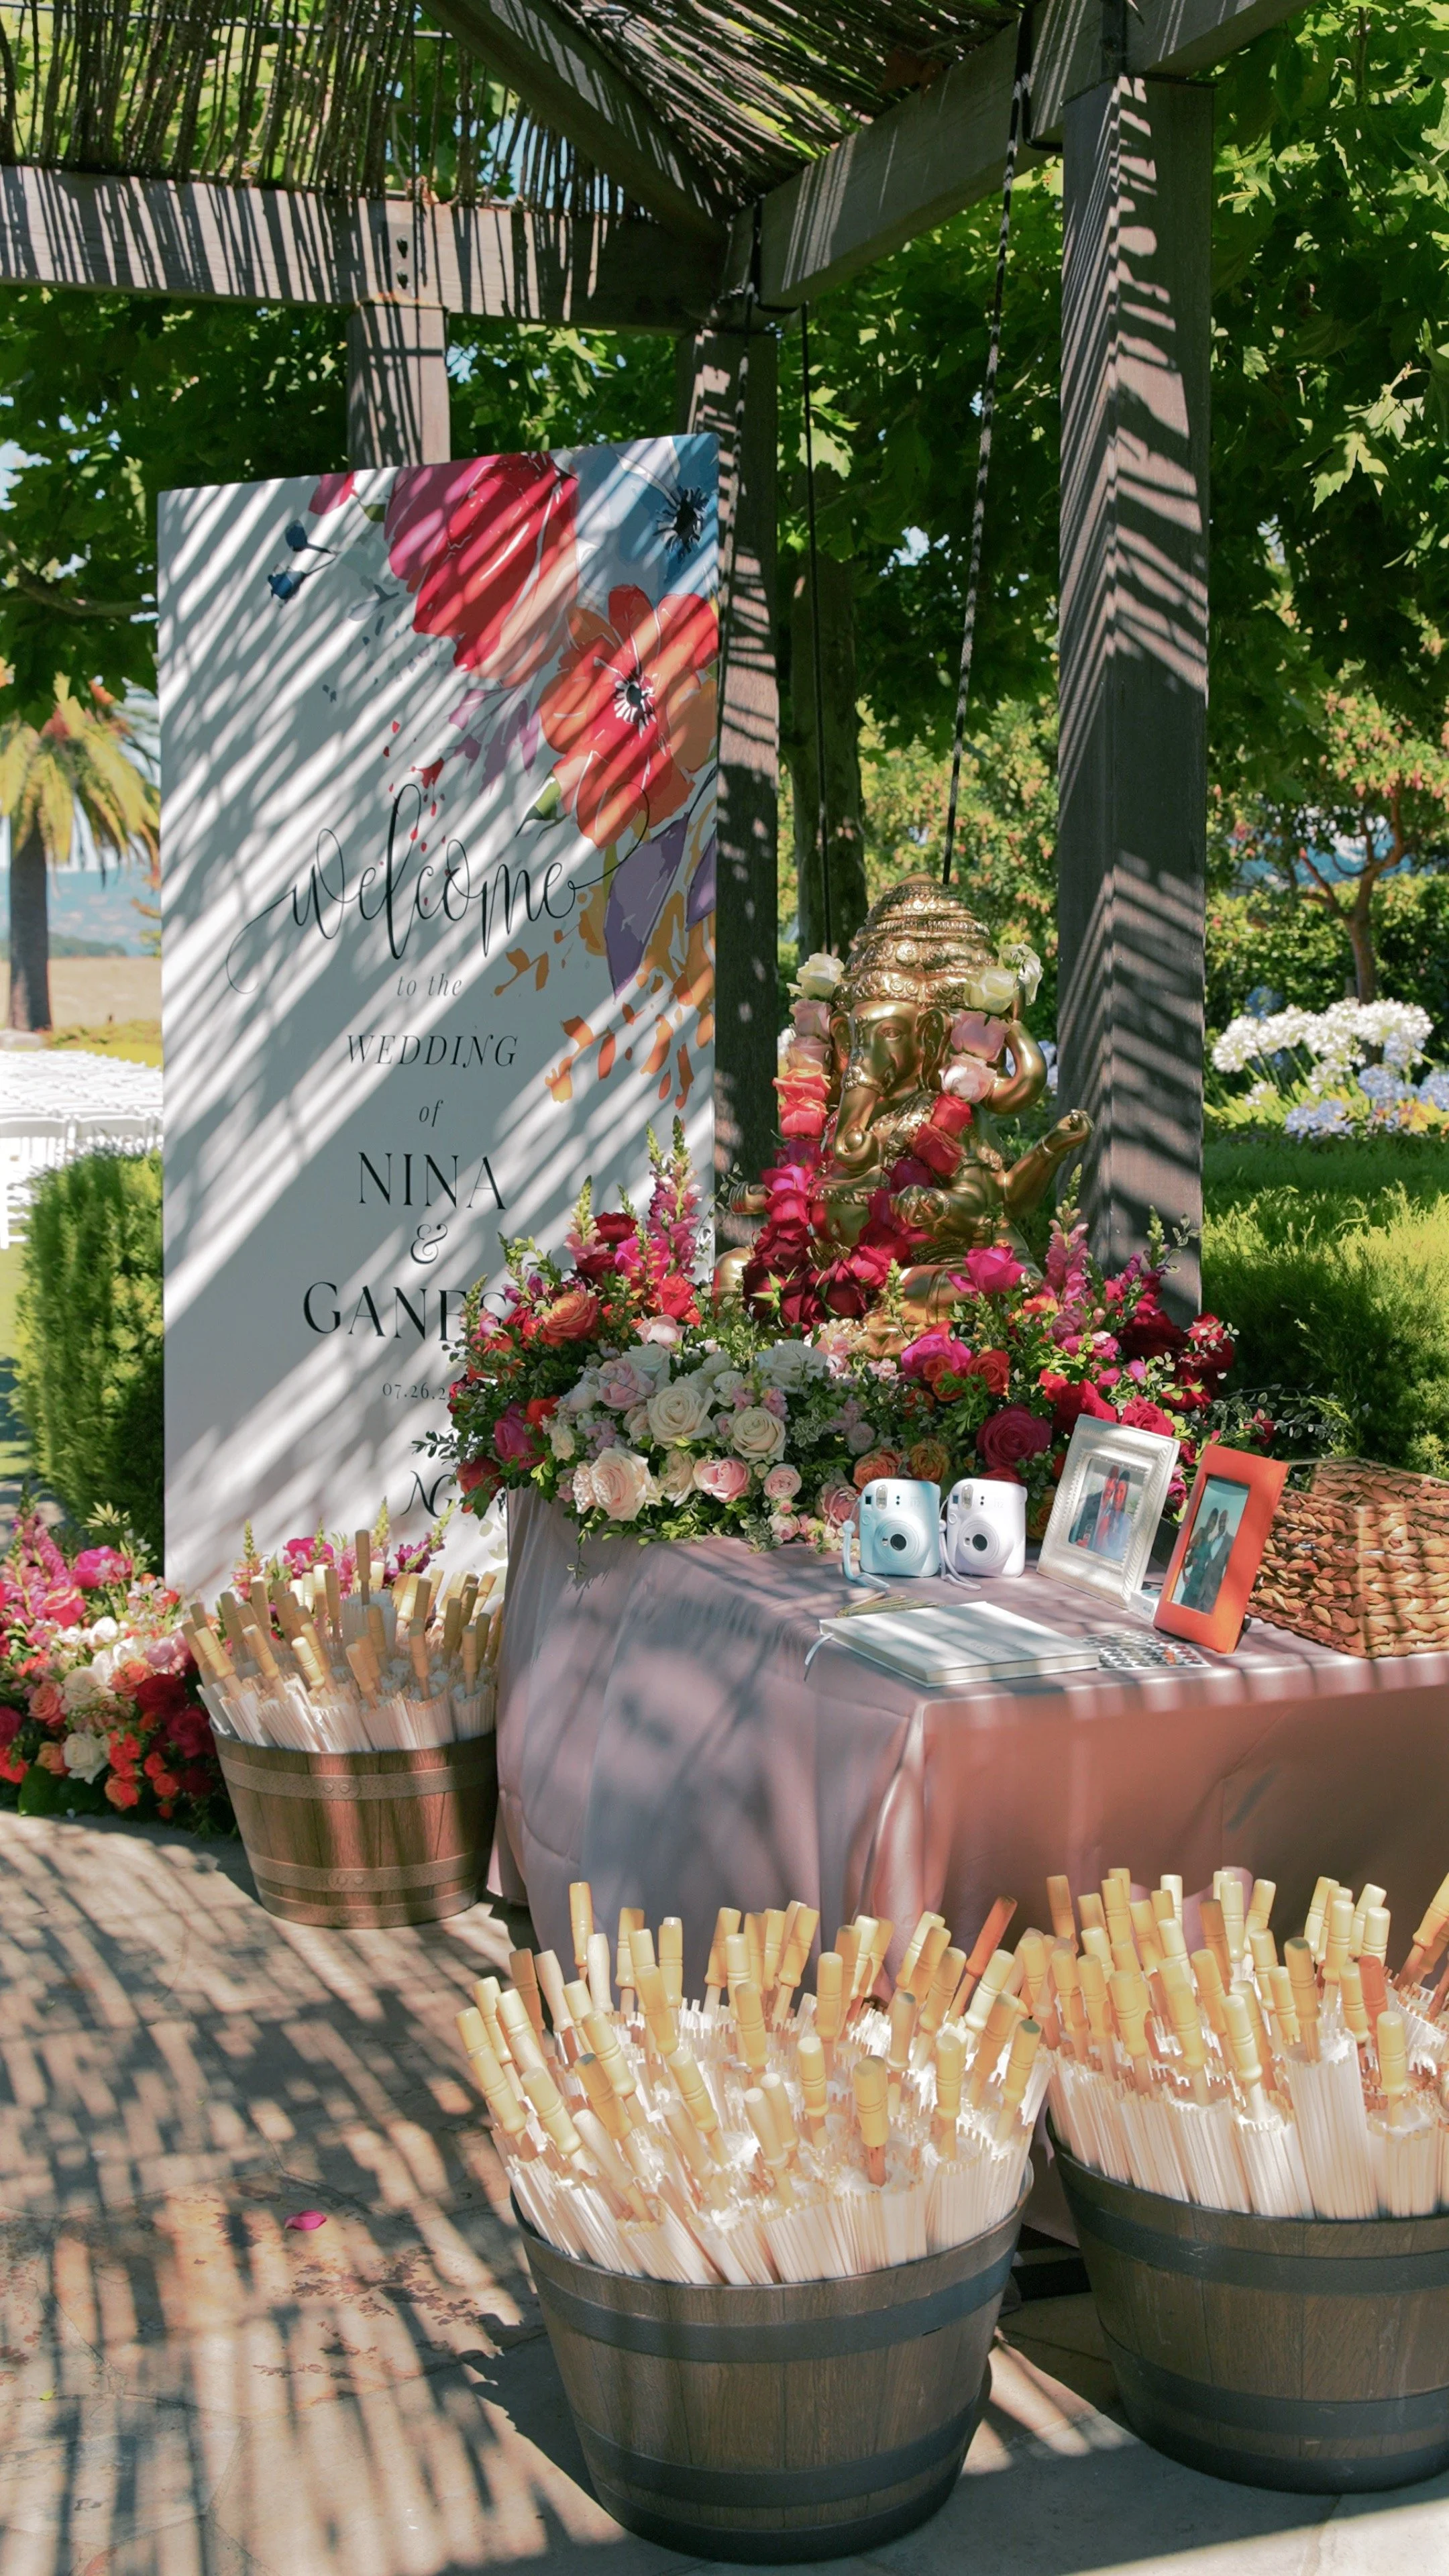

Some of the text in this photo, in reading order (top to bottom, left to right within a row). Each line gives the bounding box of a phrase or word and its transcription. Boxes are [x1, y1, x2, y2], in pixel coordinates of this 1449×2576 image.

[396, 972, 462, 996] to the
[347, 1034, 519, 1069] WEDDING
[419, 1099, 444, 1128] of
[358, 1152, 506, 1210] NINA
[410, 1223, 448, 1265] &
[382, 1382, 451, 1400] 07.26.2
